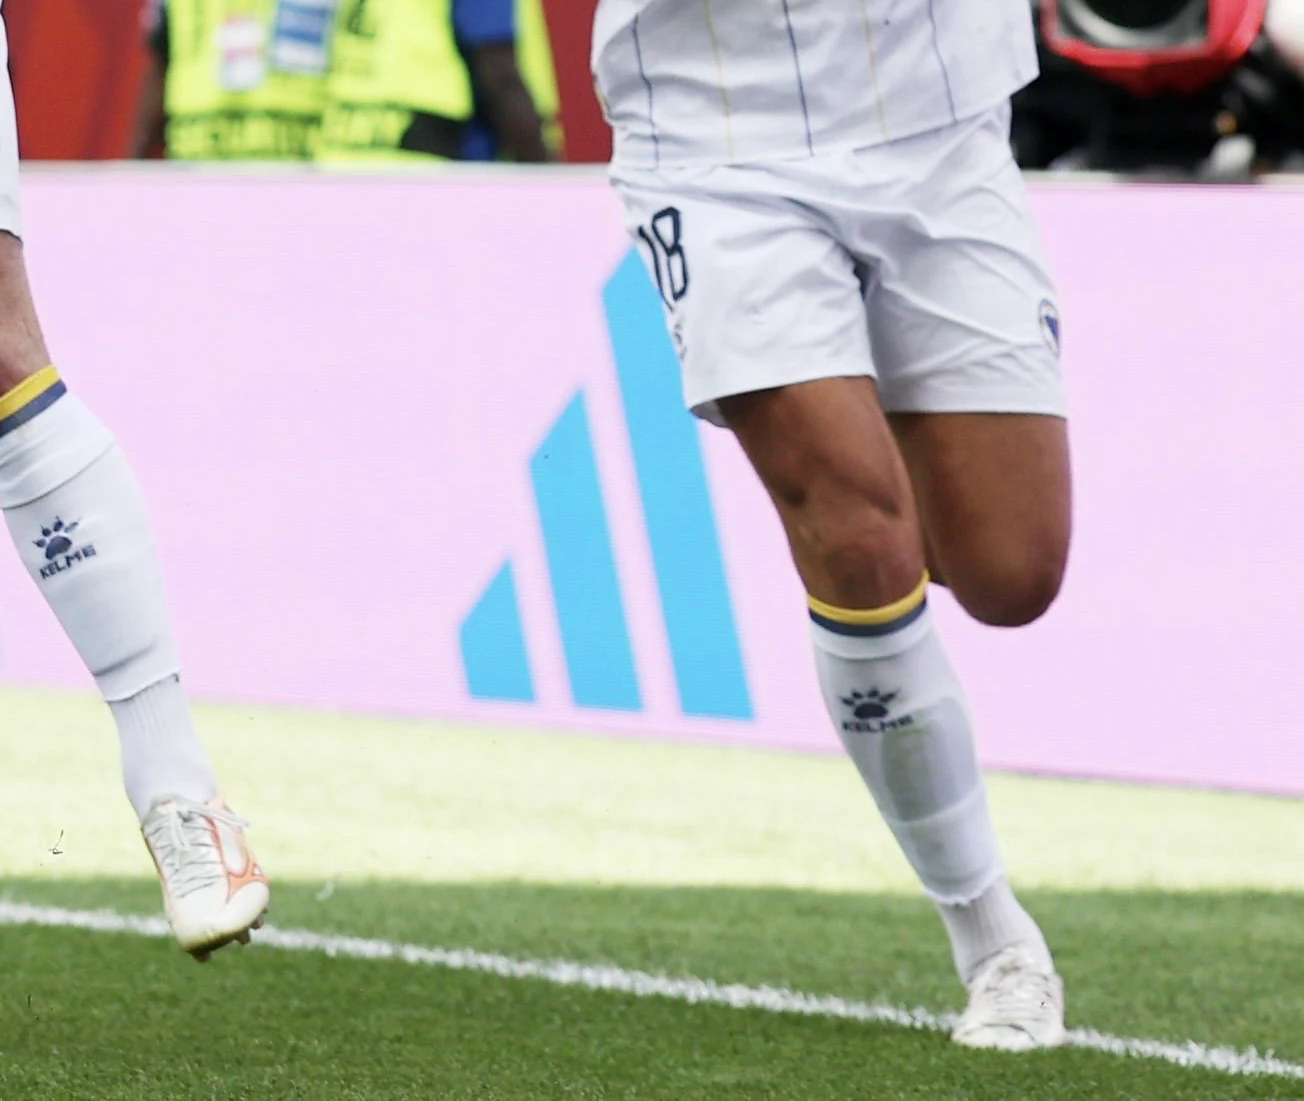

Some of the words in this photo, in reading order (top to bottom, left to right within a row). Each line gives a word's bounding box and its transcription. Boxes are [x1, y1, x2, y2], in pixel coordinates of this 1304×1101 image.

[637, 206, 690, 313] 18
[39, 543, 97, 579] KELME
[842, 714, 913, 732] KELME
